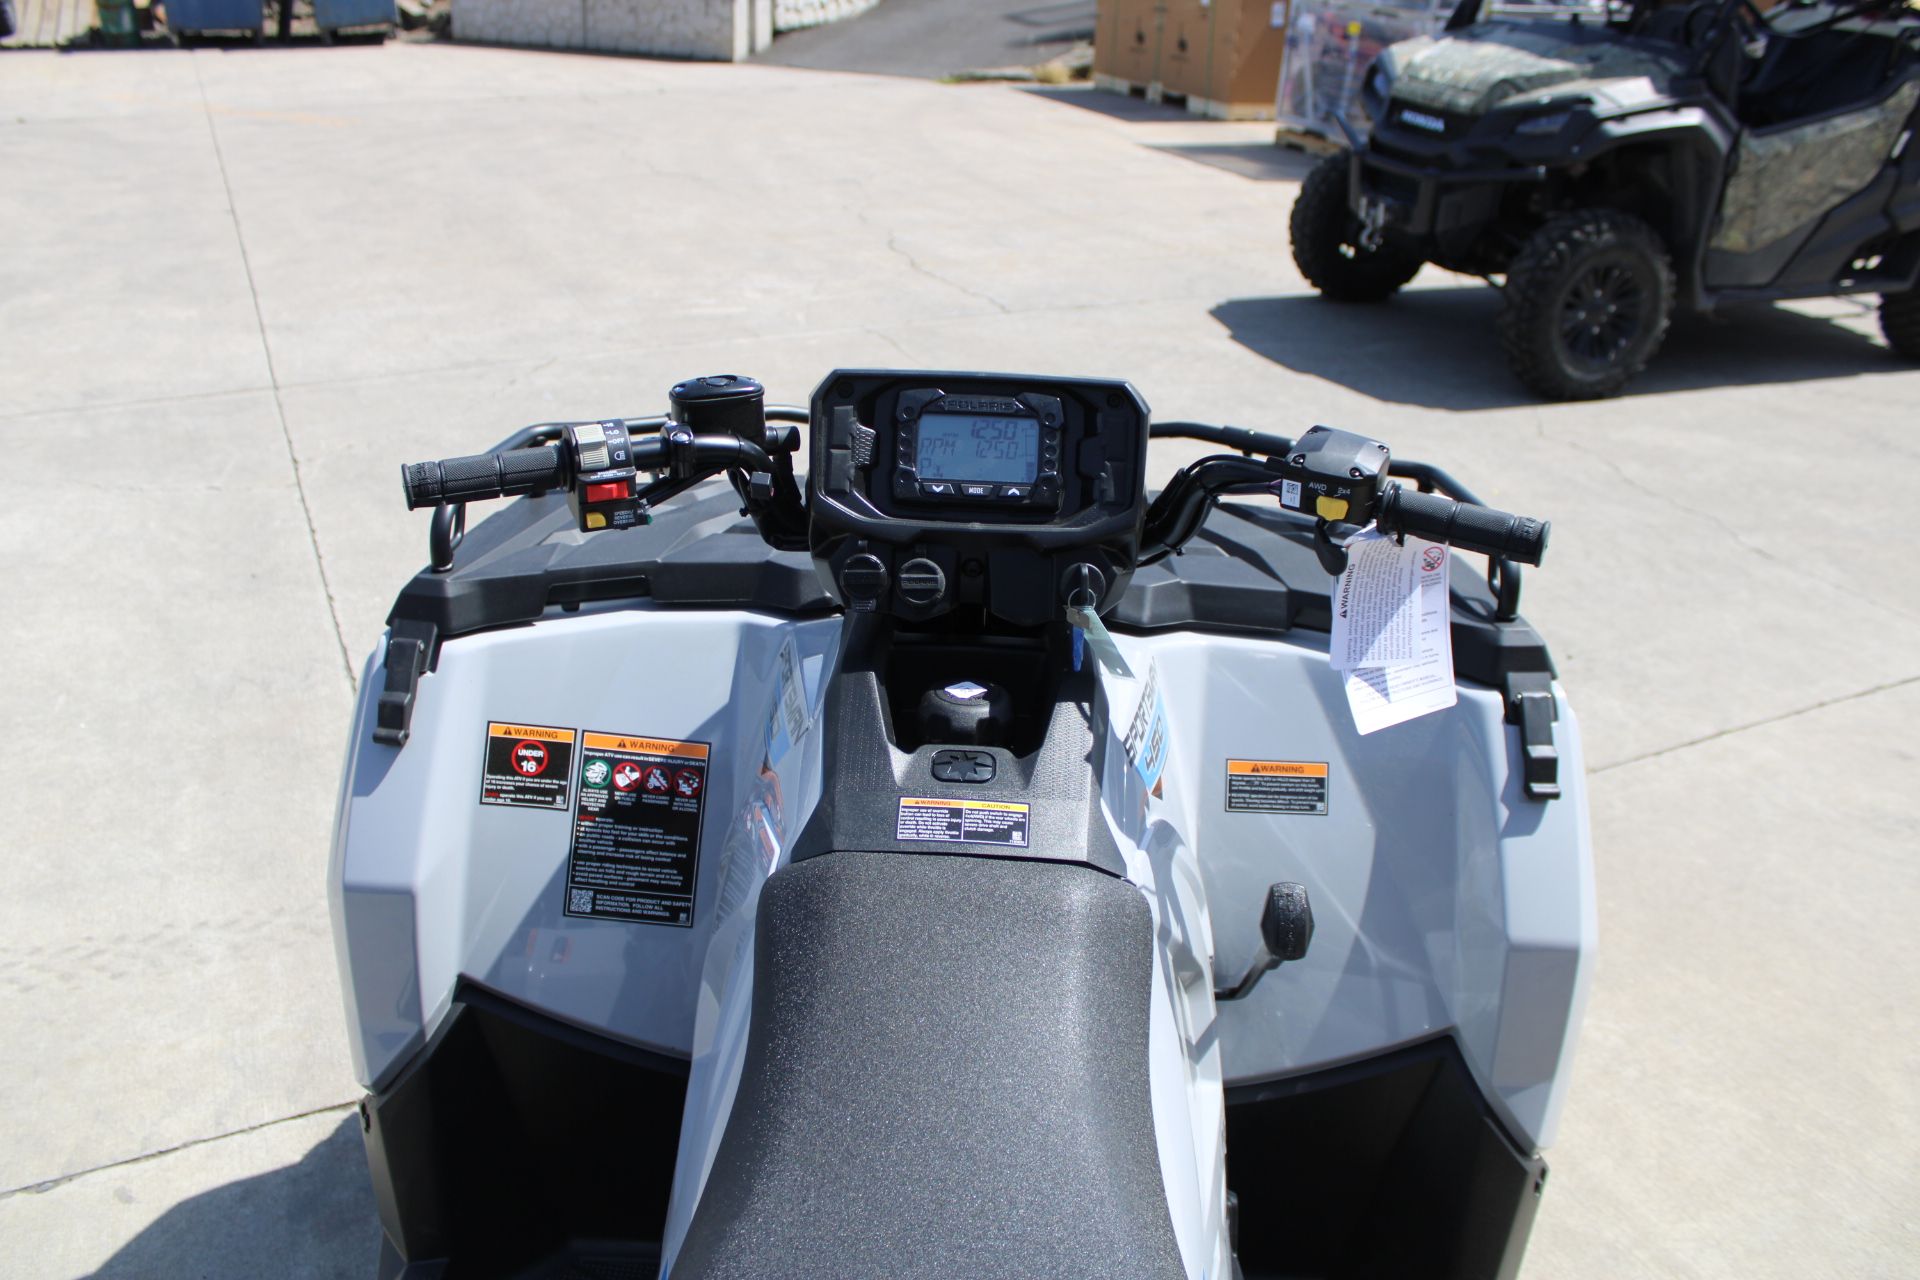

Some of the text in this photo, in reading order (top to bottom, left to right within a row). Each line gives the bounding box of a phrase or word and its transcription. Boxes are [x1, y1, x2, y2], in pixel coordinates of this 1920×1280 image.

[920, 438, 1018, 460] RPM 1250
[969, 487, 984, 495] MODE
[1308, 482, 1327, 491] AWD
[1341, 563, 1356, 611] WARNING
[514, 728, 558, 739] WARNING
[630, 741, 675, 753] WARNING
[517, 749, 544, 758] UNDER
[521, 760, 537, 772] 16
[1261, 765, 1305, 774] WARNING
